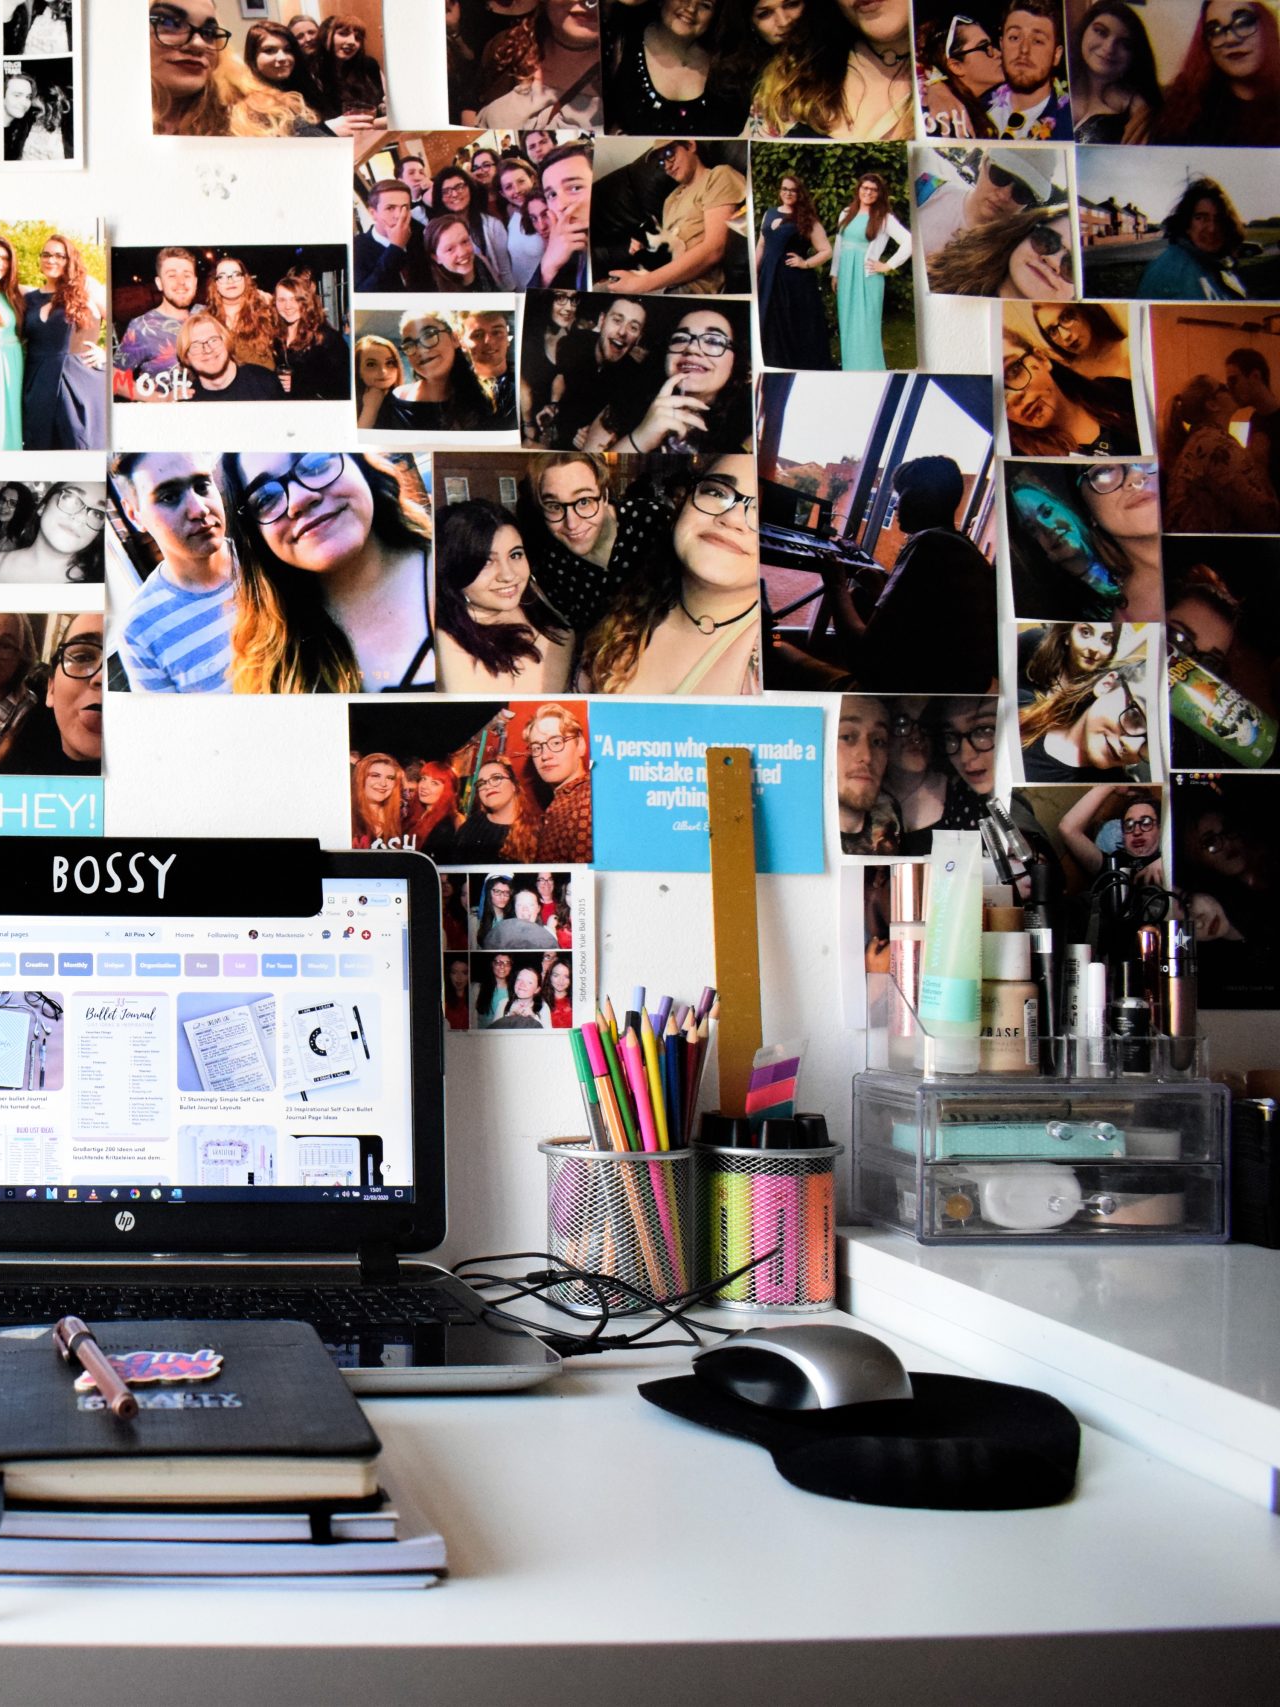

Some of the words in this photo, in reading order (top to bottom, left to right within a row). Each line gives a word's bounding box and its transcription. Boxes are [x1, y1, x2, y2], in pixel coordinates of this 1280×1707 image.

[113, 367, 193, 400] MOSH
[617, 741, 671, 760] person
[675, 737, 708, 758] who
[758, 739, 803, 760] made
[805, 745, 816, 760] a
[629, 761, 694, 783] mistake
[751, 763, 781, 784] ried
[53, 852, 177, 899] BOSSY
[207, 932, 239, 940] Following
[63, 961, 88, 970] Monthly
[579, 951, 587, 977] School
[85, 1007, 117, 1020] Bullet
[120, 1006, 157, 1021] Journal
